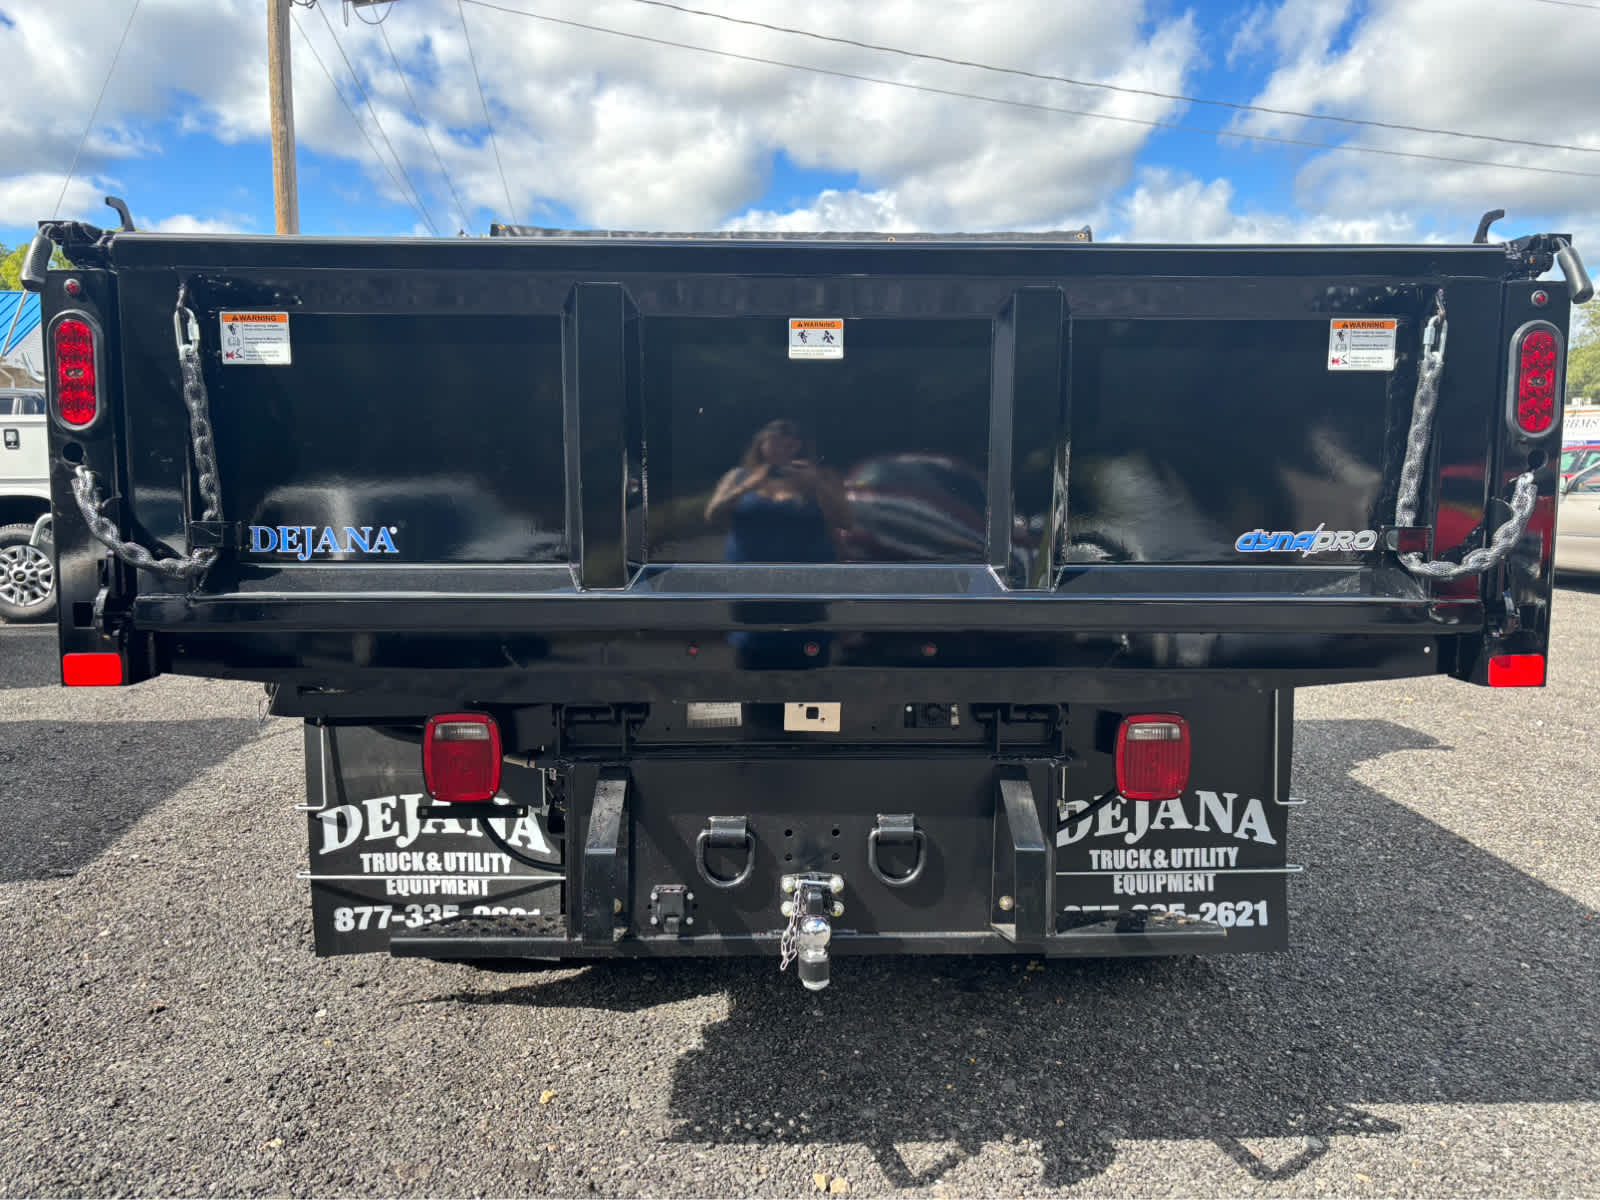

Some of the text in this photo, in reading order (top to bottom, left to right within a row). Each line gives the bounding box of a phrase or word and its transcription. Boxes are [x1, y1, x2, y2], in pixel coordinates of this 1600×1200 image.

[1350, 321, 1384, 329] WARNING
[386, 877, 490, 897] EQUIPMENT
[1113, 873, 1216, 895] EQUIPMENT
